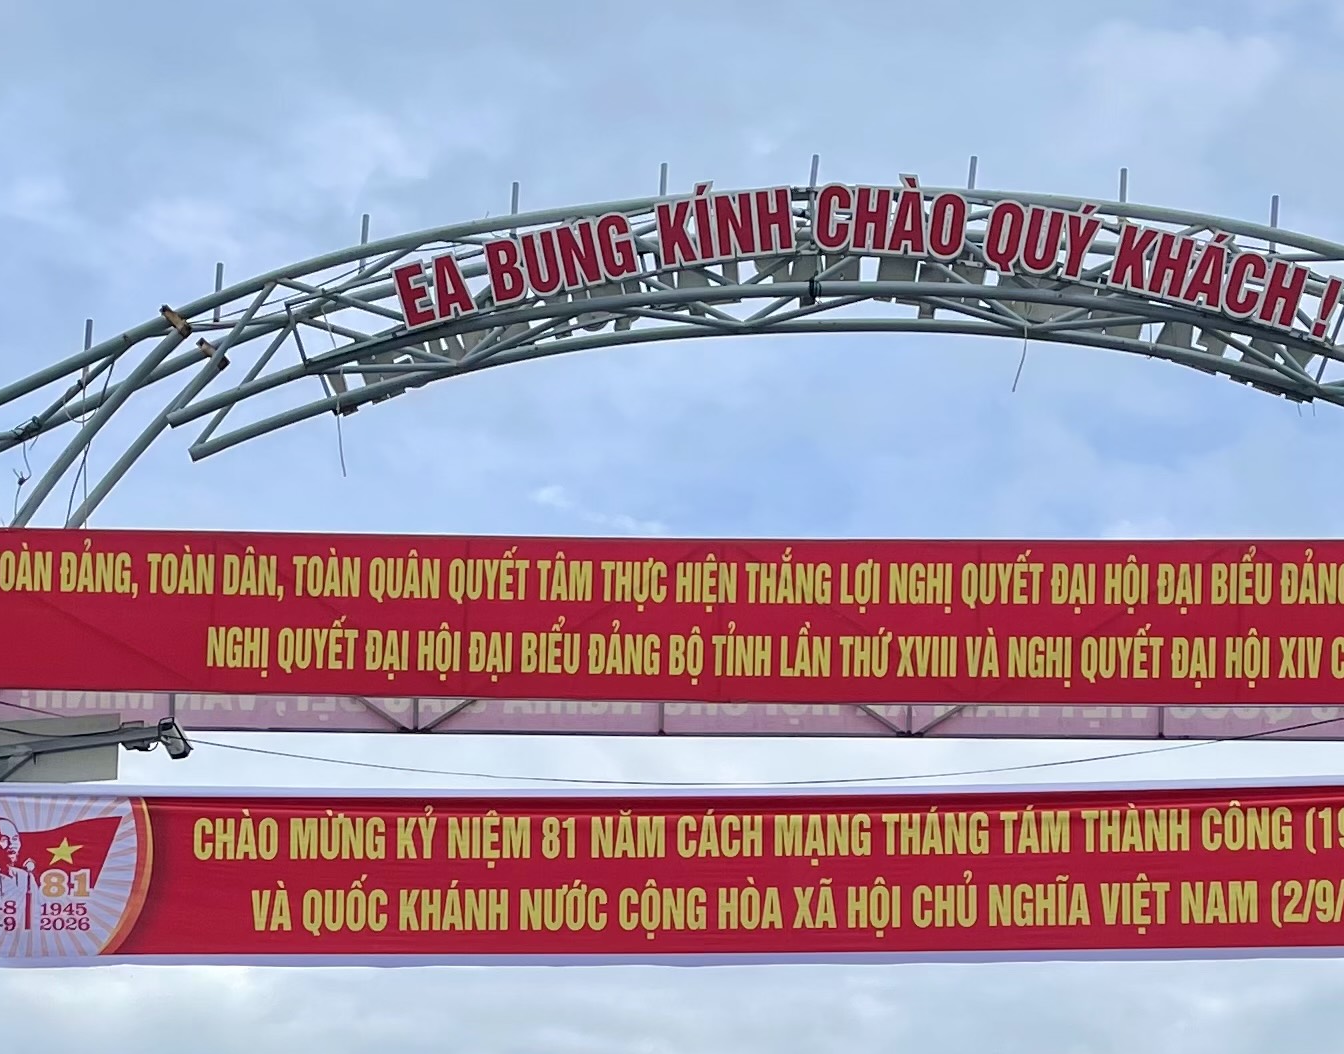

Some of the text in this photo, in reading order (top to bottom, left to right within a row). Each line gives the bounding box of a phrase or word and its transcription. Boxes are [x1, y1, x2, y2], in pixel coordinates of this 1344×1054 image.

[392, 252, 478, 330] EA
[483, 212, 639, 305] BUNG
[655, 181, 796, 270] KÍNH
[813, 173, 968, 260] CHÀO
[983, 200, 1102, 281] QUÝ
[1107, 219, 1311, 331] KHÁCH
[59, 539, 139, 597] ĐẢNG,
[146, 547, 216, 595] TOÀN
[221, 545, 285, 601] DÂN,
[293, 548, 362, 598] TOÀN
[367, 549, 442, 603] QUÂN
[447, 547, 531, 604] QUYẾT
[536, 552, 594, 602] TÂM
[599, 558, 668, 612] THỰC
[674, 553, 738, 613] HIỆN
[744, 547, 833, 605] THẮNG
[839, 559, 882, 614] LỢI
[887, 562, 954, 613] NGHỊ
[960, 550, 1045, 609] QUYẾT
[1049, 562, 1097, 614] ĐẠI
[1103, 555, 1150, 614] HỘI
[1156, 563, 1203, 614] ĐẠI
[1210, 547, 1273, 605] BIỂU
[206, 626, 270, 678] NGHỊ
[276, 617, 360, 674] QUYẾT
[364, 629, 410, 681] ĐẠI
[416, 622, 462, 682] HỘI
[467, 631, 514, 682] ĐẠI
[519, 616, 582, 675] BIỂU
[586, 619, 662, 676] ĐẢNG
[668, 625, 705, 685] BỘ
[711, 622, 773, 677] TỈNH
[779, 623, 832, 678] LẦN
[838, 628, 893, 678] THỨ
[895, 635, 959, 678] XVIII
[965, 627, 1001, 678] VÀ
[1006, 635, 1073, 688] NGHỊ
[1079, 624, 1165, 684] QUYẾT
[1170, 636, 1217, 689] ĐẠI
[1224, 627, 1271, 689] HỘI
[1278, 636, 1324, 679] XIV
[192, 809, 280, 861] CHÀO
[288, 809, 387, 860] MỪNG
[396, 806, 437, 860] KỶ
[446, 809, 532, 869] NIỆM
[541, 816, 577, 860] 81
[590, 810, 667, 859] NĂM
[676, 811, 764, 859] CÁCH
[773, 813, 872, 867] MẠNG
[881, 806, 990, 856] THÁNG
[999, 806, 1071, 854] TÁM
[1080, 805, 1191, 853] THÀNH
[1200, 799, 1294, 852] CÔNG
[40, 869, 90, 897] 81
[40, 902, 88, 917] 1945
[251, 880, 293, 932] VÀ
[301, 875, 389, 937] QUỐC
[398, 879, 510, 931] KHÁNH
[518, 879, 609, 931] NƯỚC
[618, 879, 707, 940] CỘNG
[717, 877, 784, 930] HÒA
[792, 878, 837, 929] XÃ
[846, 876, 902, 938] HỘI
[911, 870, 978, 929] CHỦ
[987, 874, 1091, 927] NGHĨA
[1099, 872, 1171, 935] VIỆT
[1179, 880, 1259, 925] NAM
[40, 917, 90, 932] 2026
